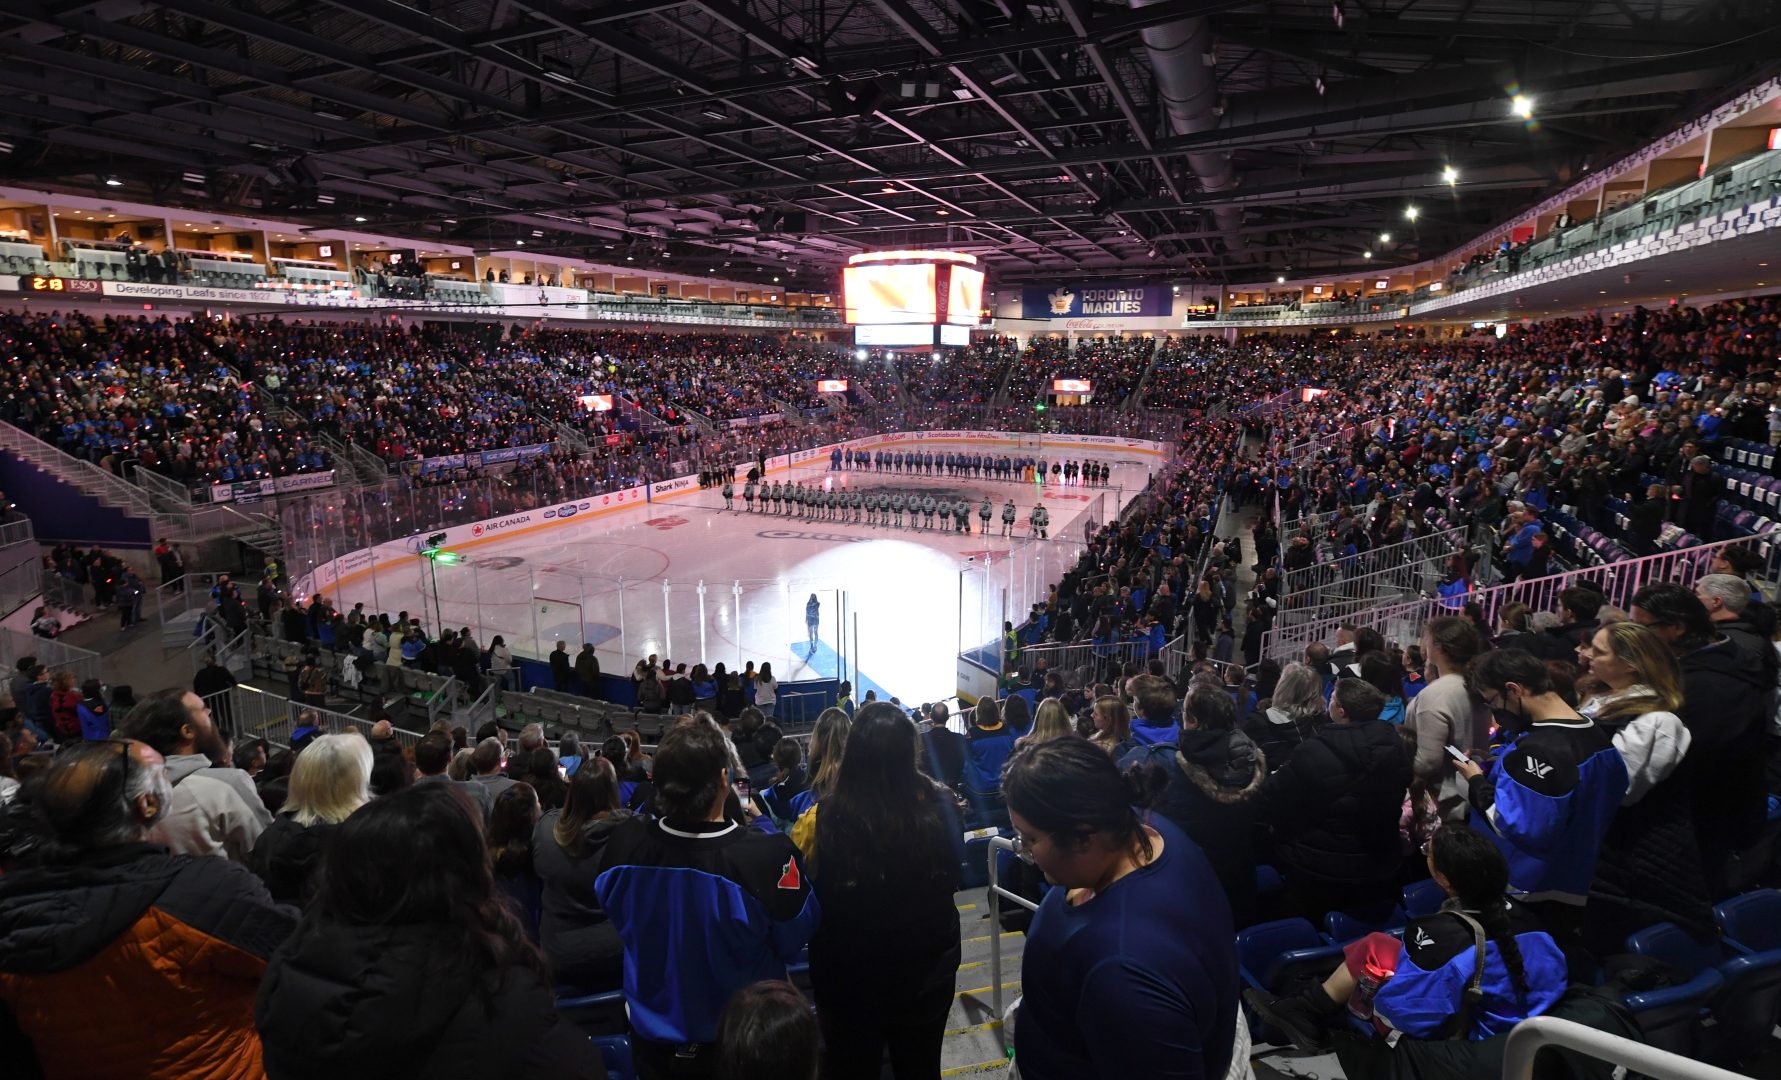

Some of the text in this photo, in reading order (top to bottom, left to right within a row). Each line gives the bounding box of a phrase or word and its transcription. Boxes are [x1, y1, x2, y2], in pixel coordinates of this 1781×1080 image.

[70, 279, 98, 292] ESQ
[116, 283, 183, 298] Developing
[186, 285, 216, 298] Leafs
[218, 287, 247, 299] since
[1080, 288, 1144, 302] TORONTO
[1082, 301, 1142, 314] MARLIES
[282, 475, 334, 489] EARNED
[655, 483, 673, 493] Shark
[486, 515, 531, 531] AIR CANADA
